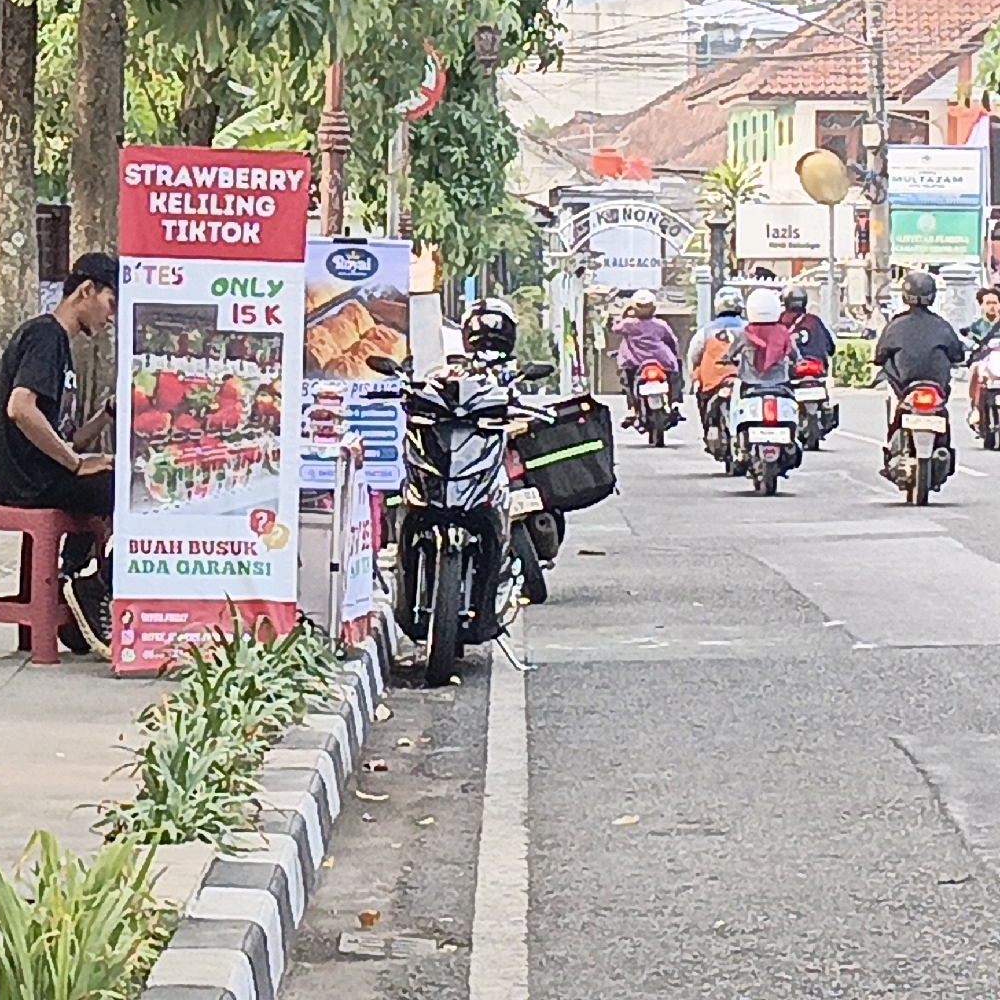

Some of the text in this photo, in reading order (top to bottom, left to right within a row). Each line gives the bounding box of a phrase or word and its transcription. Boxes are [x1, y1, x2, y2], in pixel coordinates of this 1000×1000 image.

[123, 163, 305, 191] STRAWBERRY
[149, 191, 276, 217] KELILING
[161, 219, 261, 244] TIKTOK
[210, 277, 284, 298] ONLY
[232, 303, 282, 326] 15 K
[128, 539, 258, 556] BUAH BUSUK
[127, 560, 170, 574] ADA
